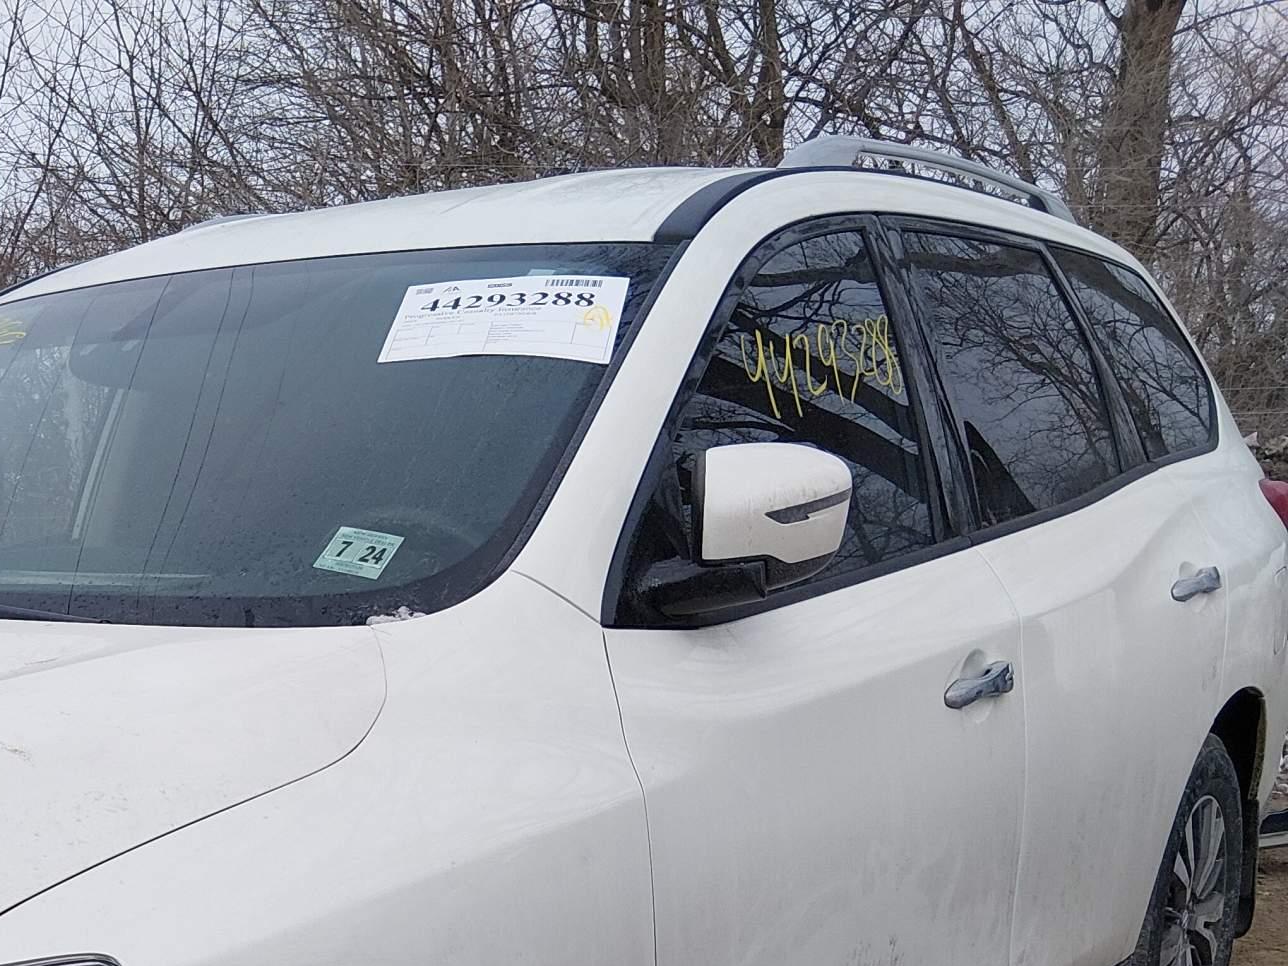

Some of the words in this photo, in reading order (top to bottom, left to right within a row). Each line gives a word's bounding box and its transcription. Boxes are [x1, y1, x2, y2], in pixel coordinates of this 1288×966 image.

[420, 292, 596, 312] 44293288
[740, 314, 903, 419] 44293288
[336, 541, 353, 557] 7
[358, 545, 387, 564] 24
